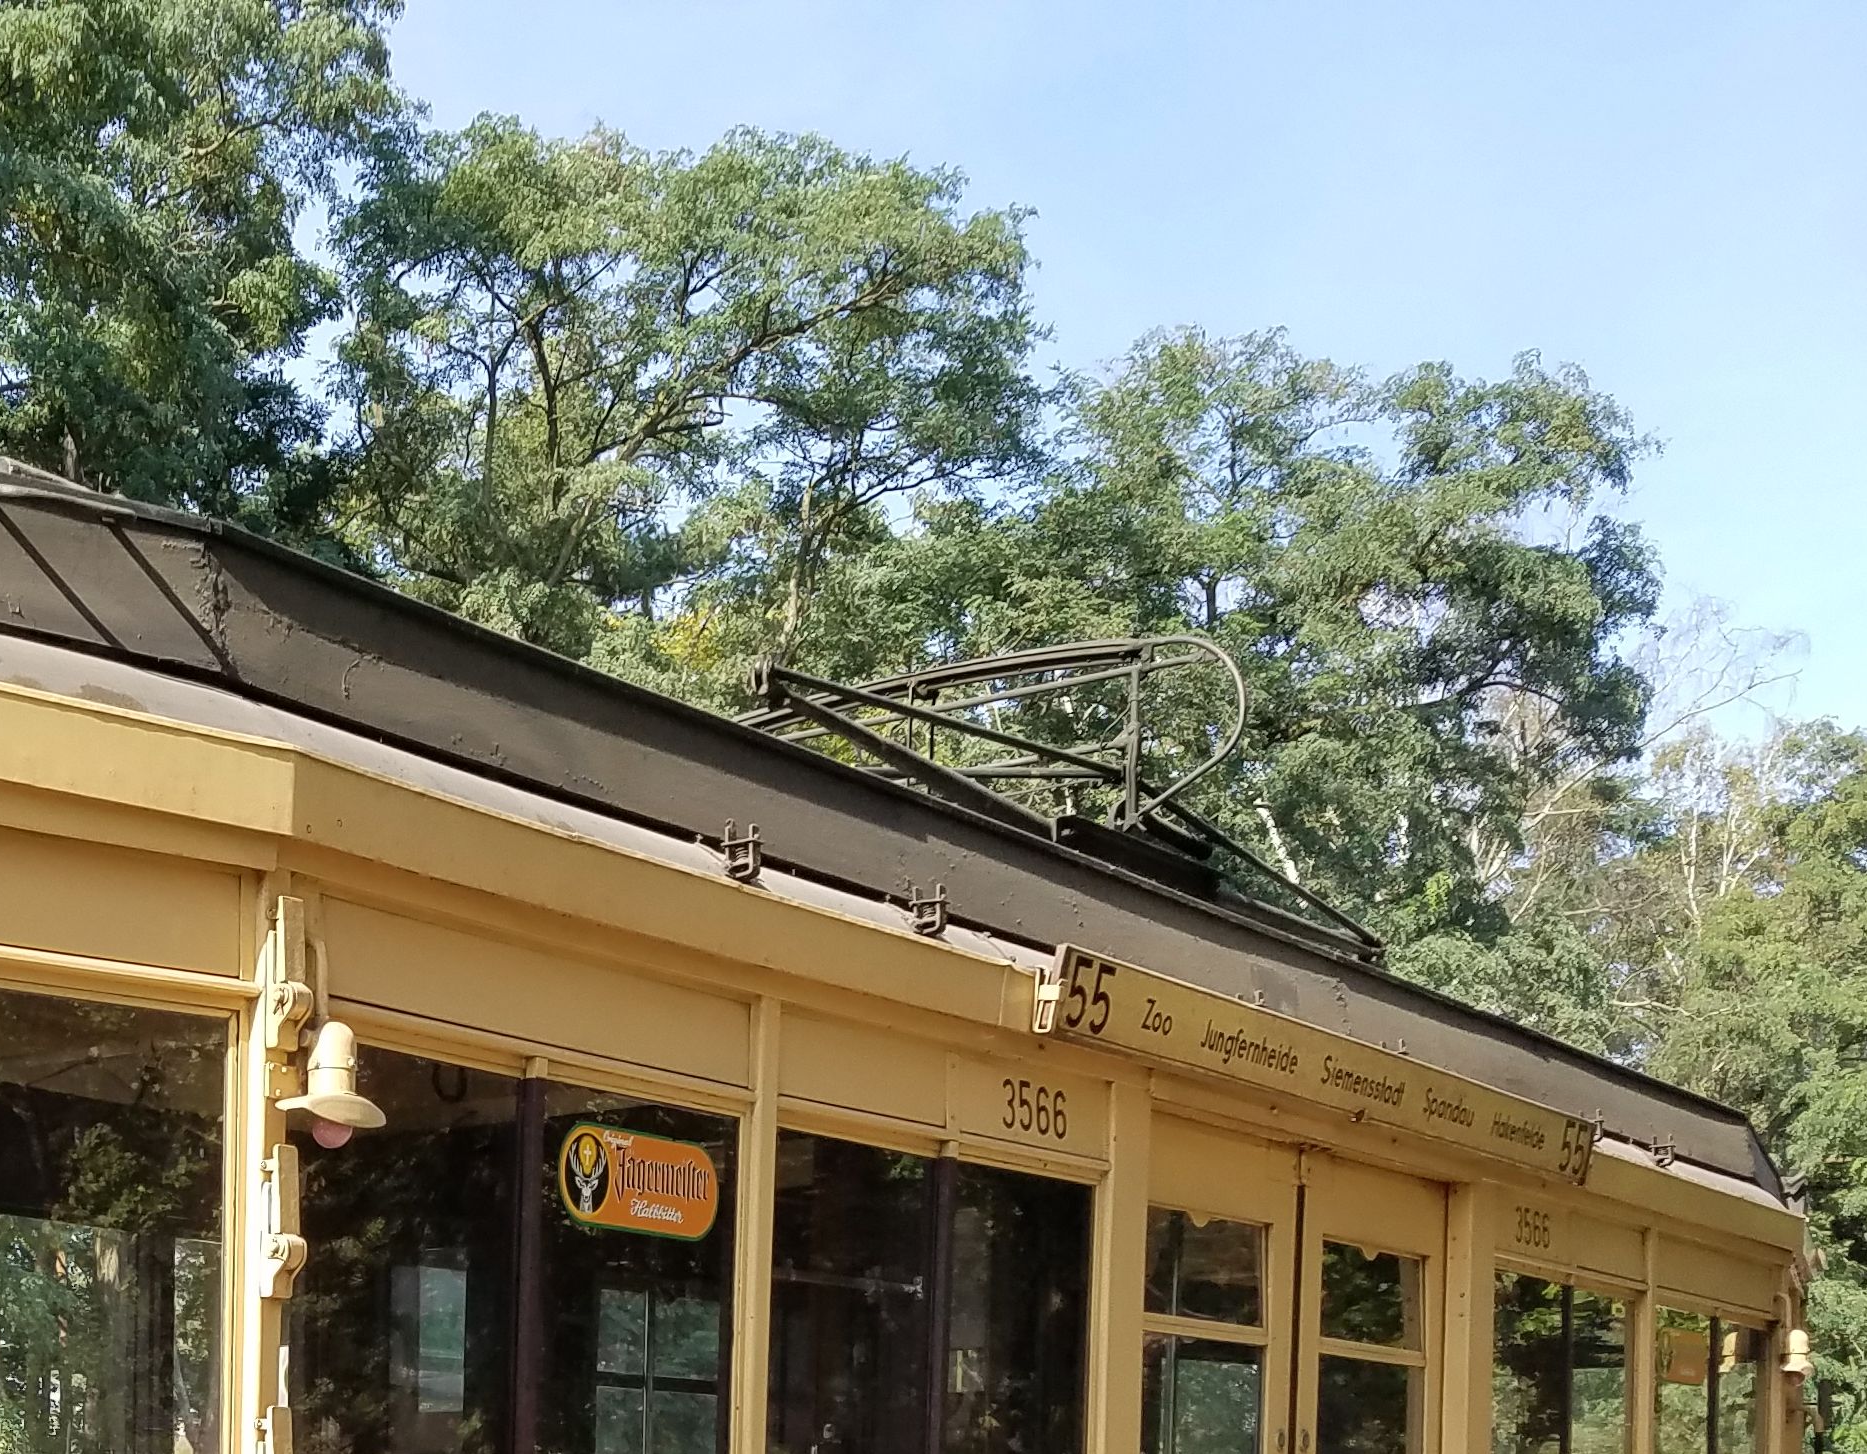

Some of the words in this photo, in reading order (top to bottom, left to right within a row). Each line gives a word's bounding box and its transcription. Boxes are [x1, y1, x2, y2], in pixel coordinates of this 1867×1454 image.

[1065, 954, 1117, 1035] 55
[1141, 998, 1173, 1036] Zoo
[1200, 1019, 1298, 1075] Jungfernheide
[1320, 1055, 1406, 1107] Siemensstadt
[1423, 1087, 1475, 1127] Spandau
[1559, 1118, 1588, 1175] 55
[1002, 1078, 1068, 1140] 3566
[1515, 1206, 1550, 1249] 3566
